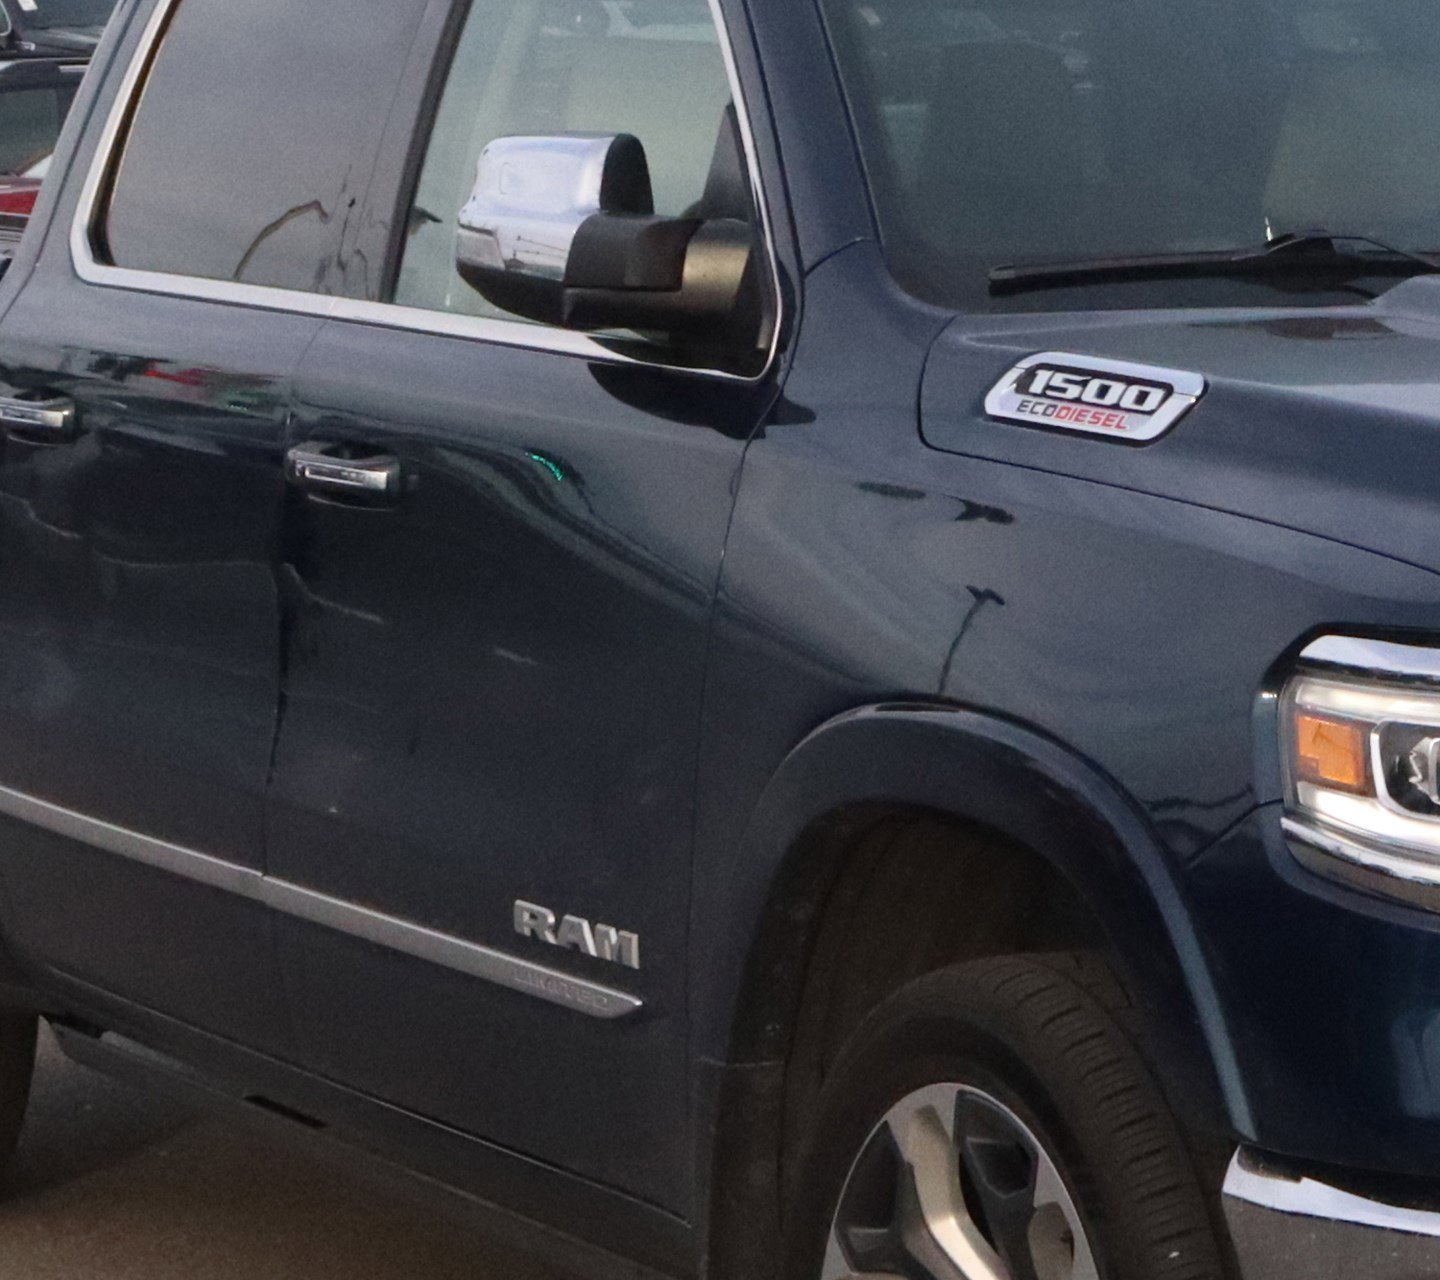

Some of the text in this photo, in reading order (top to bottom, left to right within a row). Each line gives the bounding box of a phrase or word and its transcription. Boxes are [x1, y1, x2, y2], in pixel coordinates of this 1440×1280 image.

[1027, 369, 1166, 412] 1500
[1015, 399, 1128, 430] ECODIESEL
[513, 899, 641, 970] RAM
